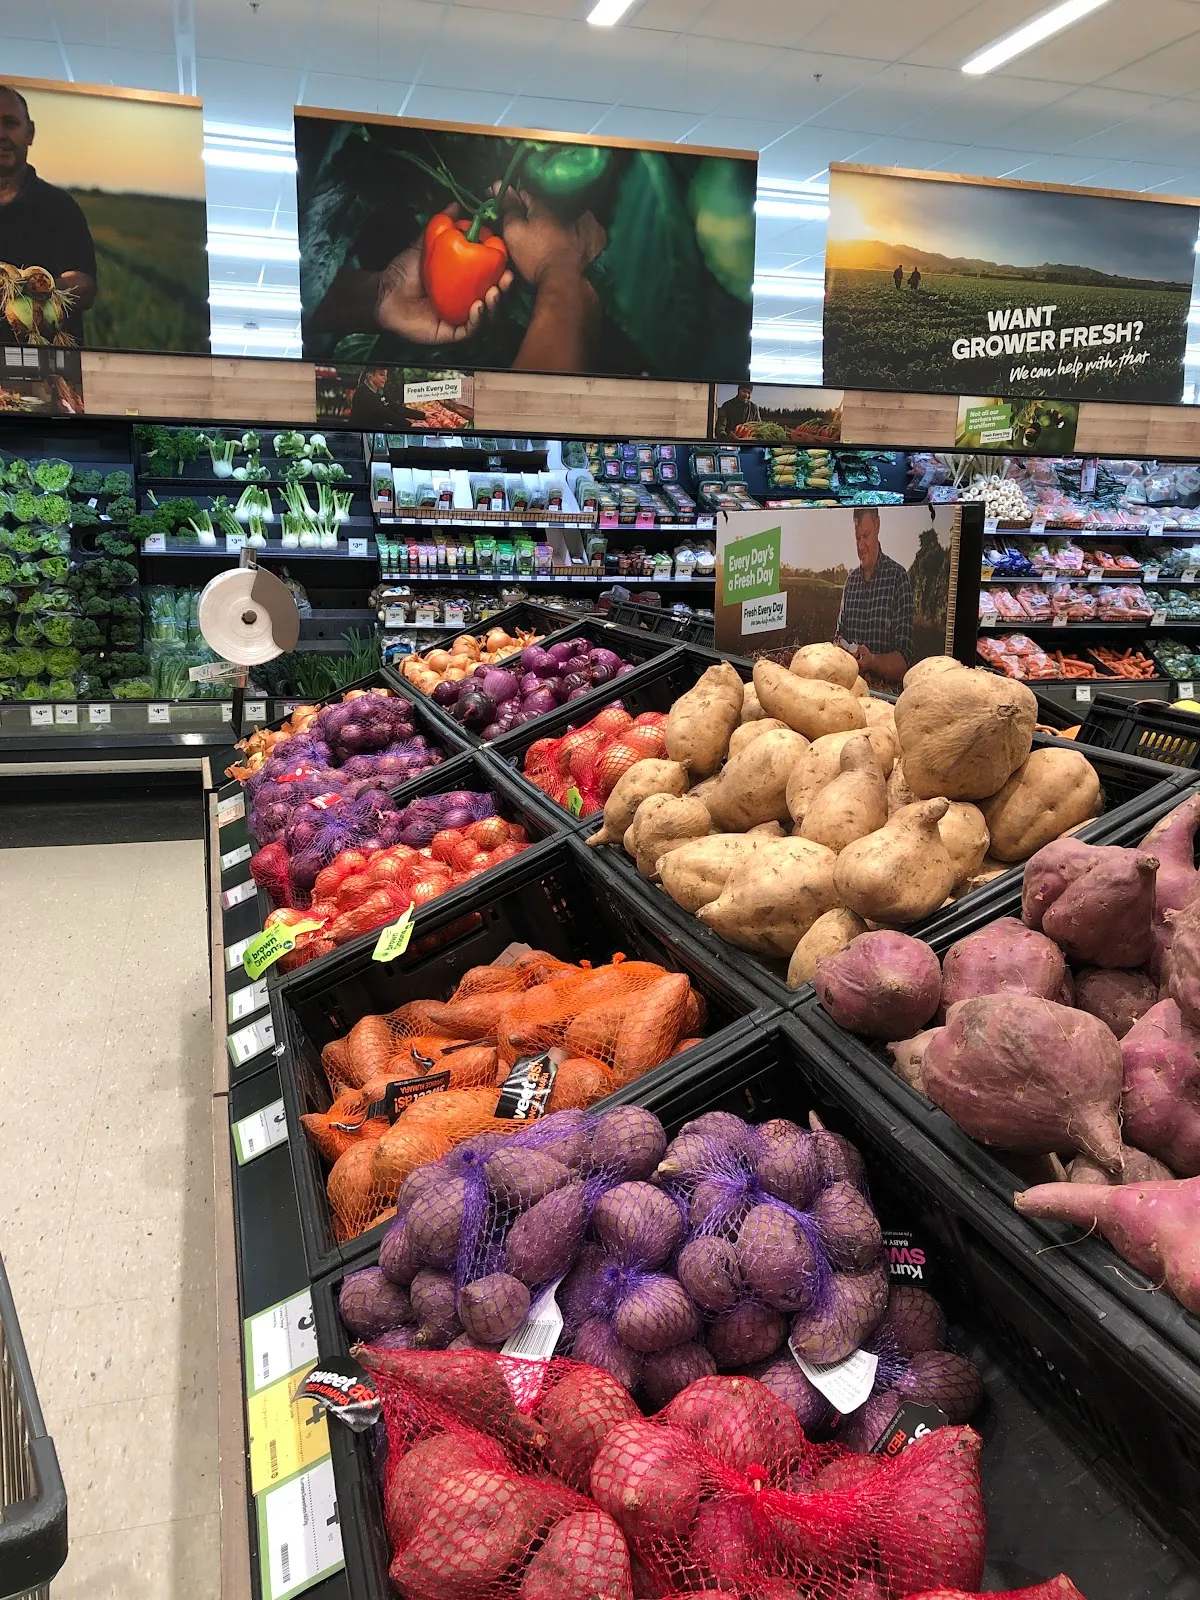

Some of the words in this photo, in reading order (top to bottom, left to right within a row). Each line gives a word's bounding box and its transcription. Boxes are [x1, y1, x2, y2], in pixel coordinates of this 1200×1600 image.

[987, 305, 1057, 332] WANT
[951, 330, 1056, 360] GROWER
[1059, 321, 1144, 350] FRESH?
[1009, 364, 1029, 383] We
[1030, 366, 1057, 378] can
[1057, 355, 1084, 378] help
[1084, 355, 1118, 374] with
[1118, 345, 1151, 369] that
[407, 386, 425, 394] Fresh
[444, 383, 458, 391] Day
[729, 552, 751, 572] Every
[751, 544, 774, 568] Day's
[728, 580, 733, 591] a
[734, 571, 756, 590] Fresh
[756, 567, 774, 586] Day
[743, 606, 757, 619] Fresh
[757, 604, 772, 616] Every
[772, 602, 784, 615] Day
[251, 936, 278, 960] brown
[305, 1370, 358, 1392] sweet
[317, 1384, 349, 1406] KUMARA
[887, 1428, 907, 1455] RED
